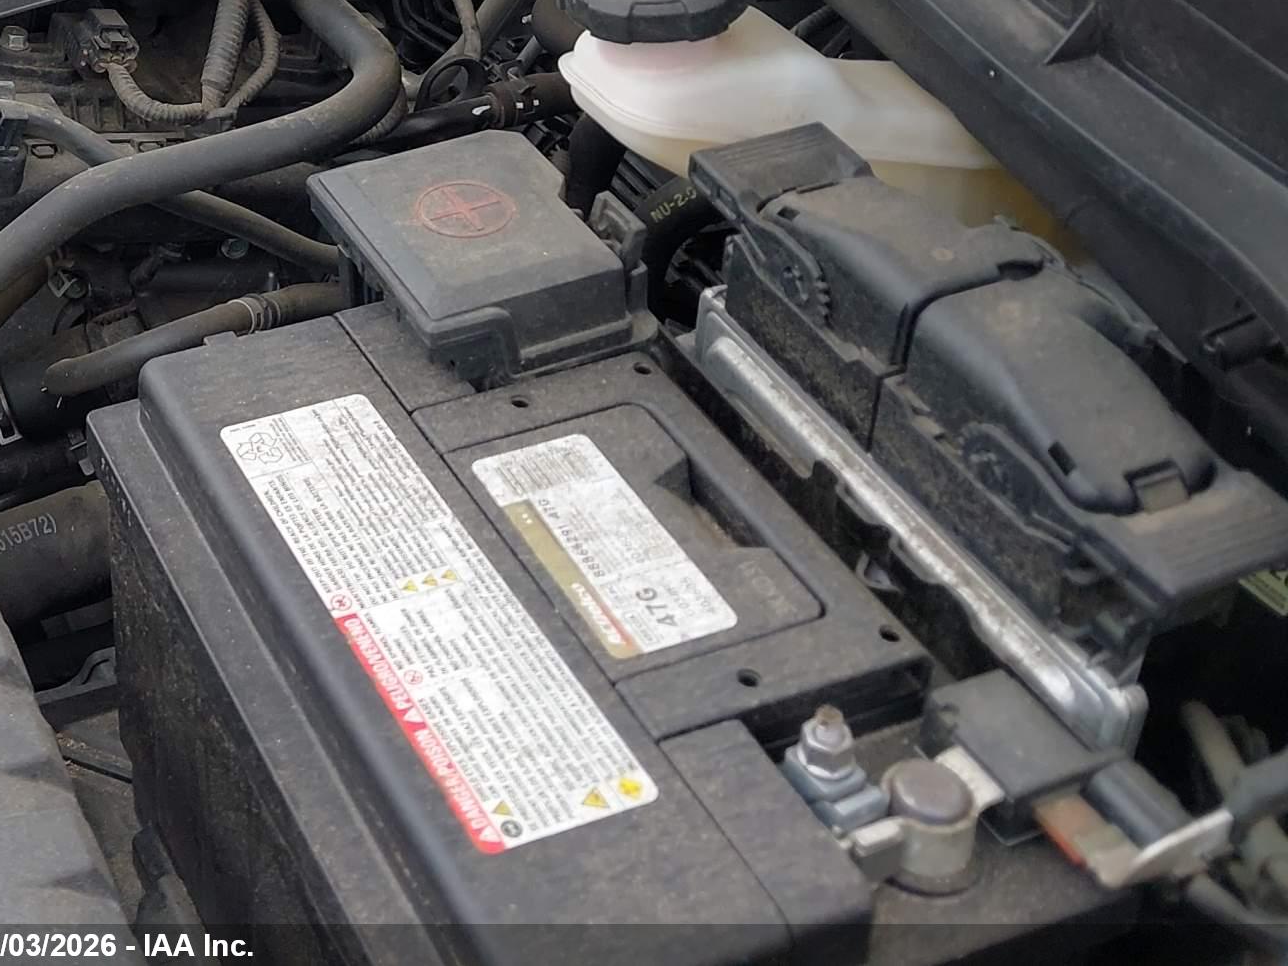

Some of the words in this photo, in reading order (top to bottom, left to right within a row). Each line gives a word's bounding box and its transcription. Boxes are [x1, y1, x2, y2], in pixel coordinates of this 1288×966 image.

[632, 585, 681, 630] 47G
[342, 616, 413, 710] PELIGRO/VENENO
[413, 726, 490, 830] DANGER/POISON
